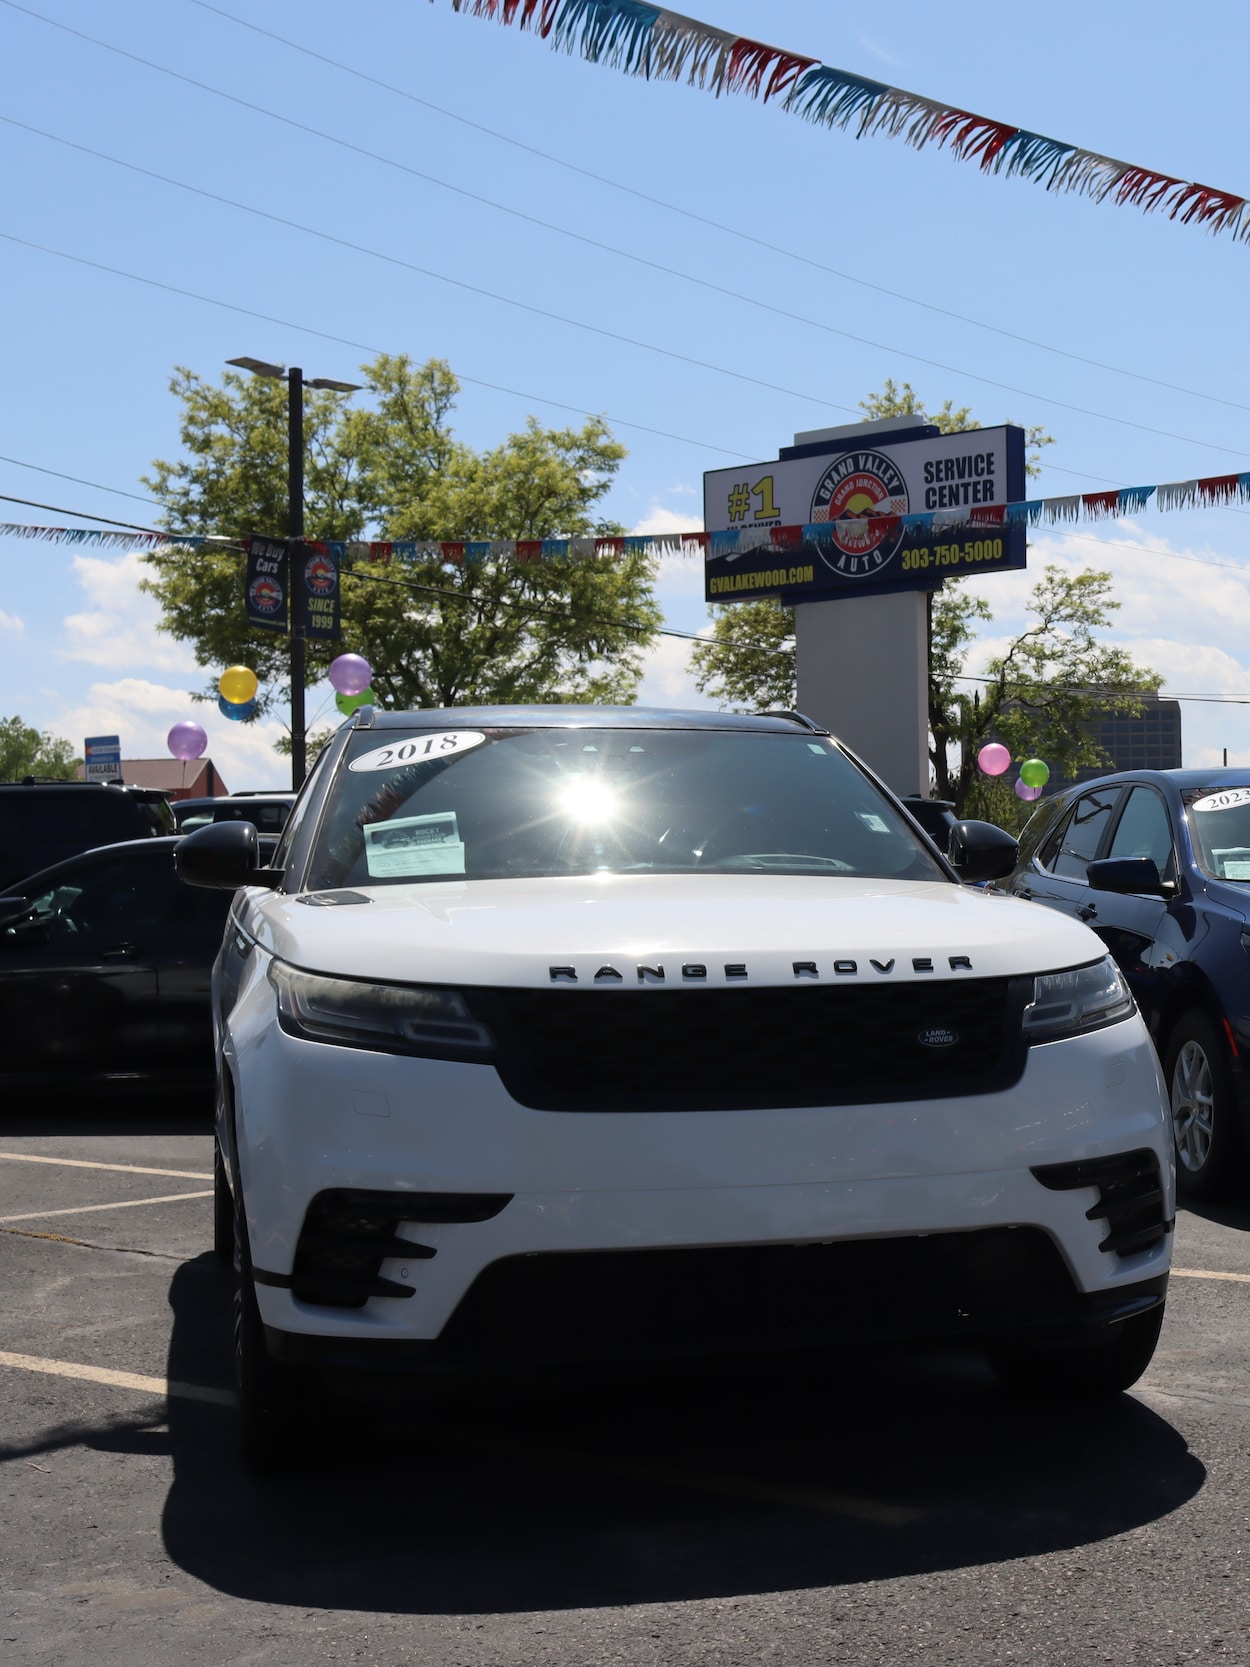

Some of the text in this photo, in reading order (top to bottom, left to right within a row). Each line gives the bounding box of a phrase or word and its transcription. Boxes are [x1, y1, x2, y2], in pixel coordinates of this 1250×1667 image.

[820, 455, 900, 500] GRAND VALLEY
[923, 452, 995, 484] SERVICE
[728, 475, 781, 523] #1
[925, 479, 995, 510] CENTER
[251, 541, 285, 562] We Buy
[837, 549, 883, 573] AUTO
[901, 539, 1003, 571] 303-750-5000
[255, 558, 279, 574] Cars
[710, 565, 814, 594] GVALAKEWOOD.COM
[307, 597, 336, 613] SINCE
[311, 614, 334, 630] 1999
[376, 734, 458, 767] 2018
[415, 826, 440, 836] ROCKY
[548, 955, 973, 979] RANGE ROVER
